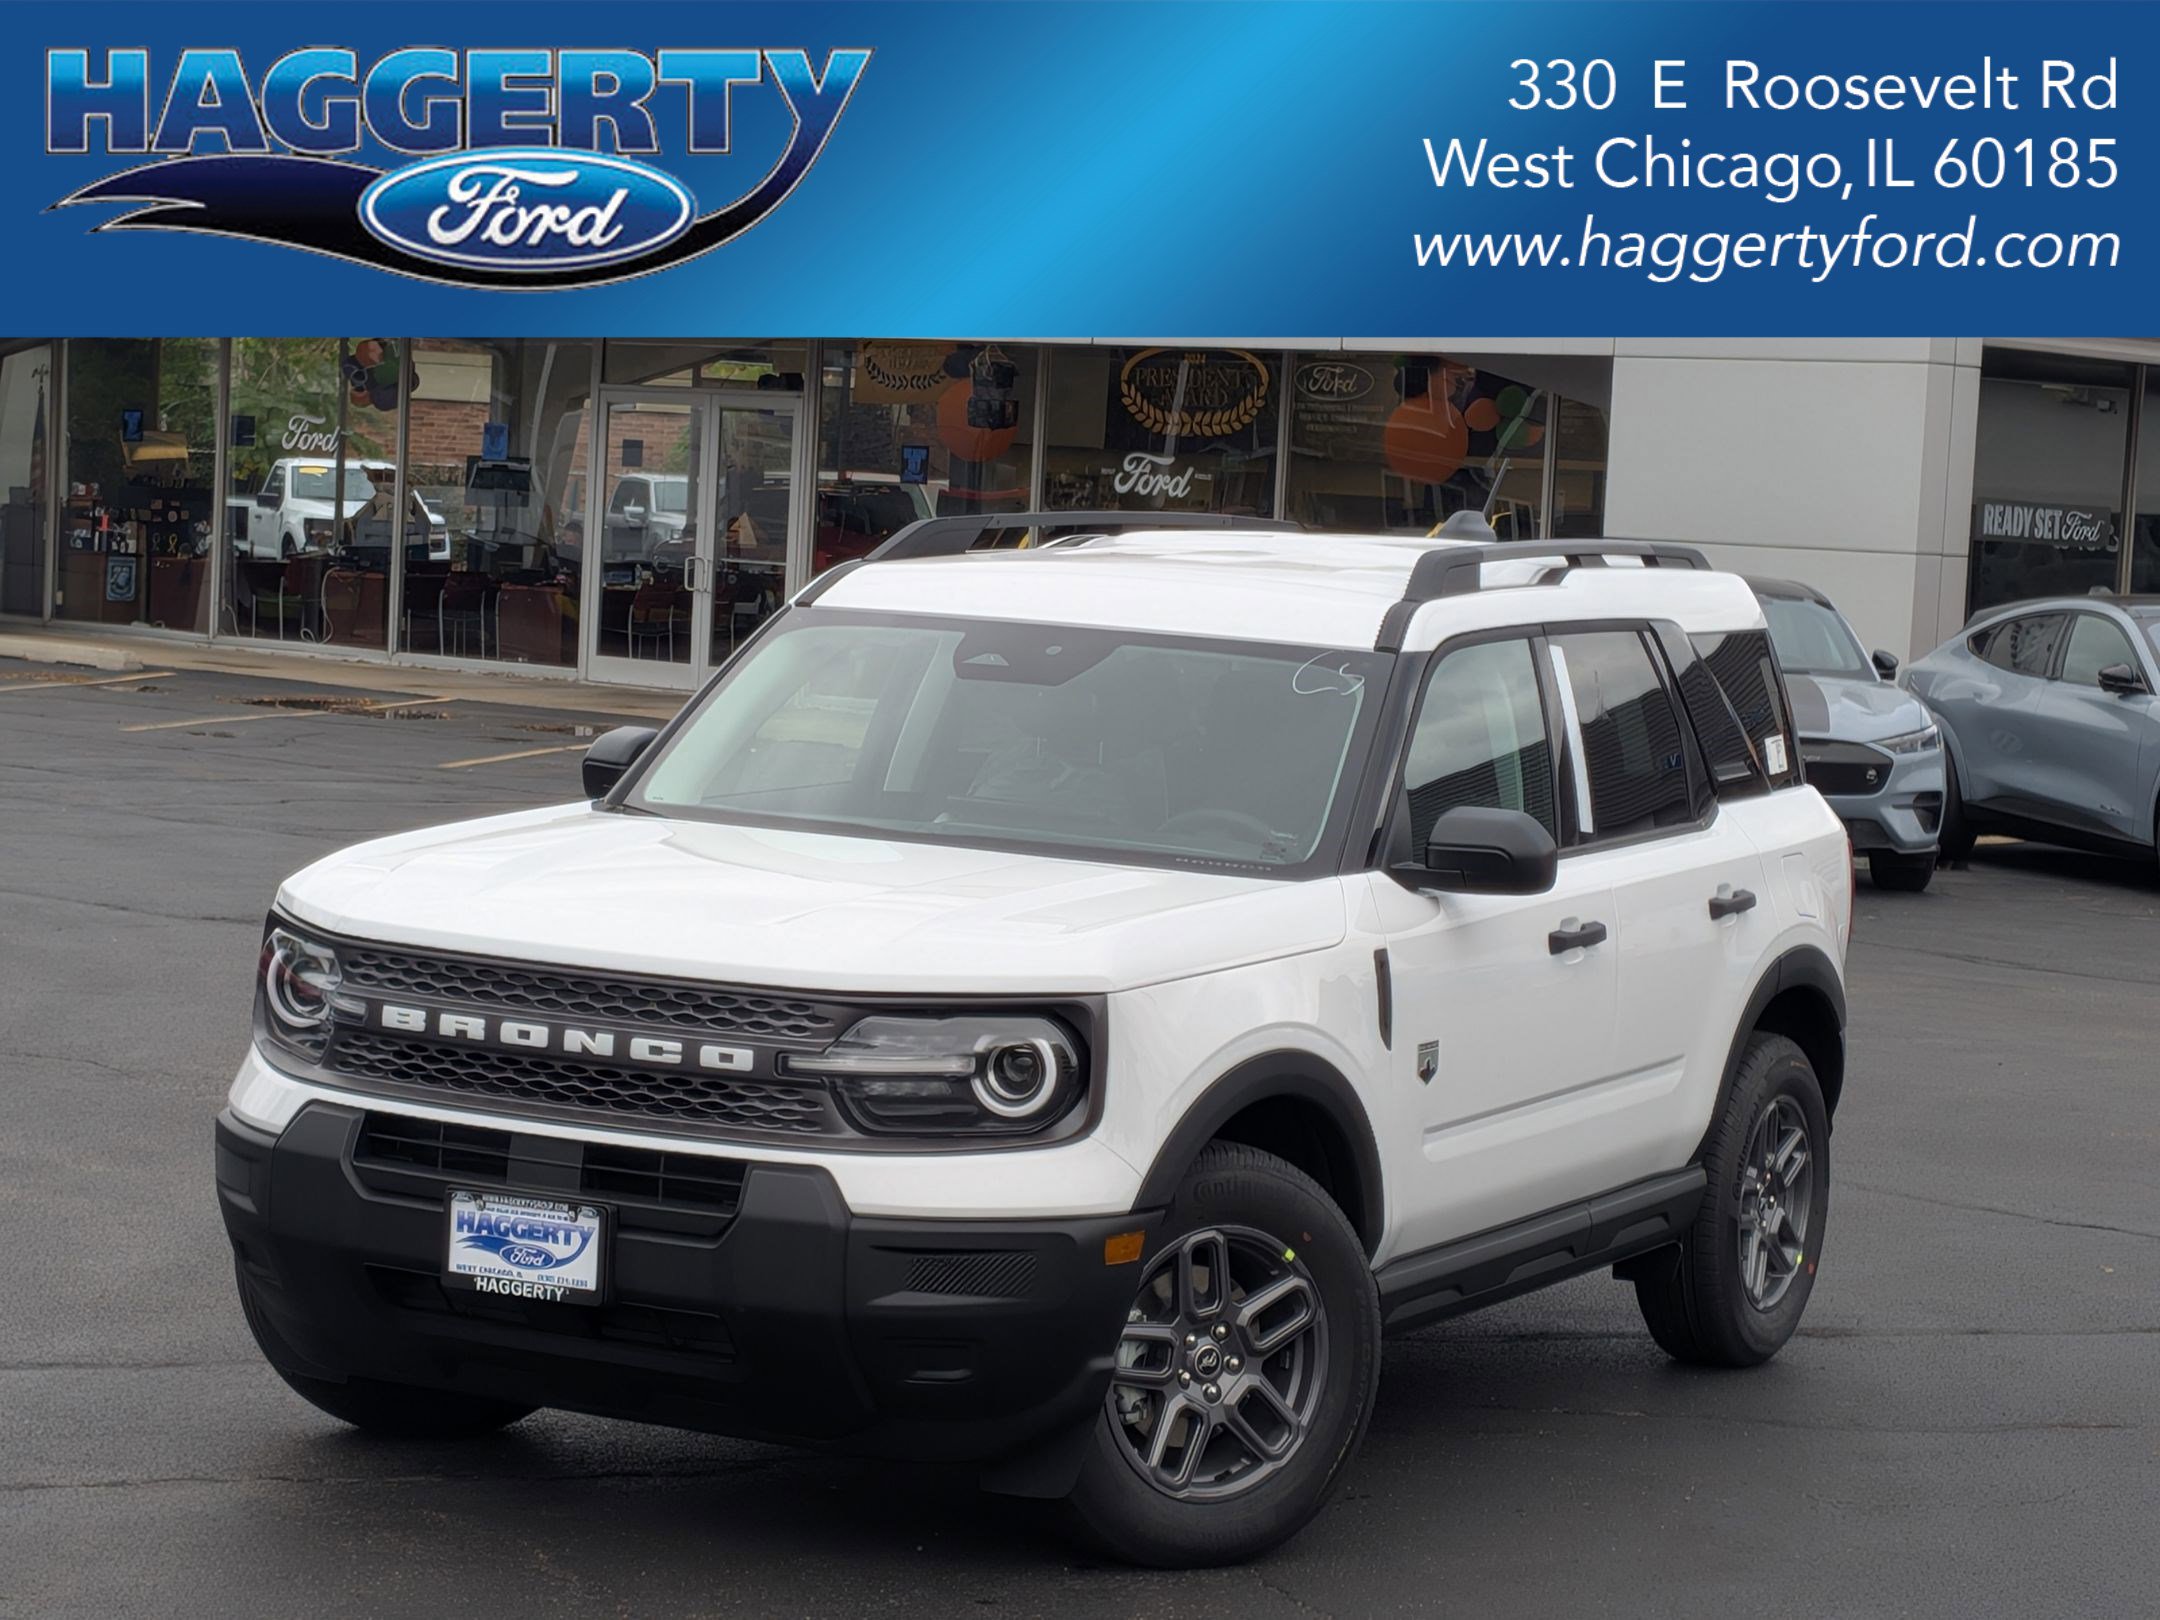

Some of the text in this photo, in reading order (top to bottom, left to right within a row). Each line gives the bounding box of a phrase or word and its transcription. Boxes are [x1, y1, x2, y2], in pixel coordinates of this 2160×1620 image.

[1308, 366, 1358, 393] Ford
[281, 414, 340, 453] Ford
[1114, 452, 1195, 498] Ford
[1983, 503, 2105, 542] READY SET Ford
[381, 1004, 754, 1072] BRONCO
[456, 1209, 597, 1247] HAGGERTY
[510, 1246, 546, 1267] Ford
[475, 1277, 566, 1302] HAGGERTY
